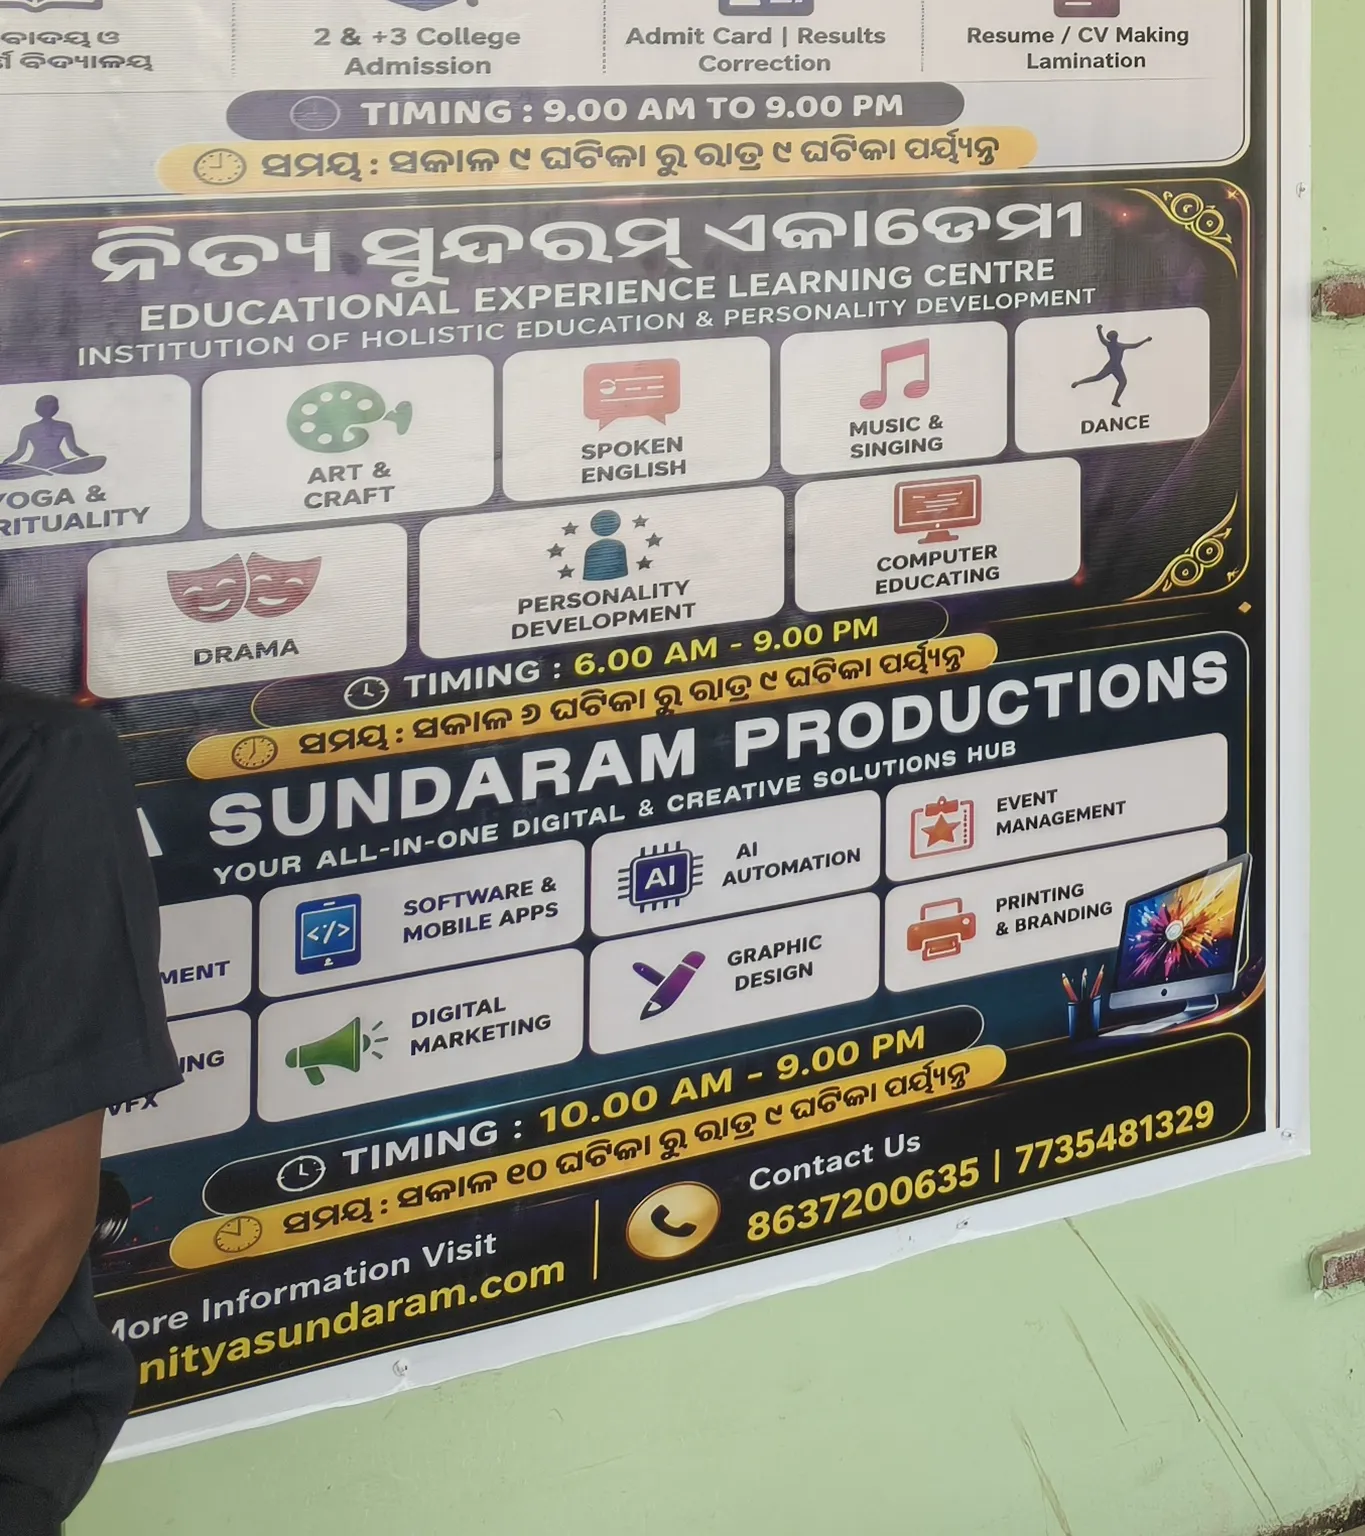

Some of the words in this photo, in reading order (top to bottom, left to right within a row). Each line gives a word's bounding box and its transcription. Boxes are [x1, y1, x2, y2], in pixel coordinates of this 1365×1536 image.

[626, 26, 705, 46] Admit
[712, 26, 773, 46] Card
[797, 26, 886, 45] Results
[966, 26, 1054, 44] Resume
[1077, 26, 1109, 44] CV
[1116, 26, 1189, 48] Making
[698, 54, 831, 73] Correction
[1026, 51, 1146, 70] Lamination
[141, 289, 460, 332] EDUCATIONAL
[473, 276, 715, 313] EXPERIENCE
[728, 266, 912, 298] LEARNING
[924, 259, 1055, 287] CENTRE
[78, 335, 295, 366] INSTITUTION
[307, 332, 350, 352] OF
[361, 323, 505, 348] HOLISTIC
[516, 313, 685, 340] EDUCATION
[696, 310, 714, 327] &
[724, 298, 904, 327] PERSONALITY
[916, 287, 1096, 315] DEVELOPMENT
[876, 544, 998, 573] COMPUTER
[875, 567, 1000, 596] EDUCATING
[209, 729, 695, 847] SUNDARAM
[735, 650, 1228, 766] PRODUCTIONS
[996, 789, 1058, 813] EVENT
[996, 799, 1126, 836] MANAGEMENT
[721, 849, 861, 887] AUTOMATION
[736, 842, 758, 859] AI
[403, 880, 534, 916] SOFTWARE
[541, 876, 557, 892] &
[996, 883, 1085, 913] PRINTING
[403, 913, 492, 944] MOBILE
[499, 902, 559, 928] APPS
[995, 921, 1009, 937] &
[1015, 901, 1113, 932] BRANDING
[727, 935, 822, 967] GRAPHIC
[735, 962, 813, 992] DESIGN
[411, 997, 506, 1028] DIGITAL
[410, 1015, 551, 1057] MARKETING
[342, 1121, 499, 1176] TIMING
[539, 1084, 658, 1133] 10.00
[670, 1068, 732, 1105] AM
[776, 1044, 860, 1081] 9.00
[872, 1025, 926, 1059] PM
[747, 1157, 980, 1242] 8637200635
[1016, 1100, 1215, 1175] 7735481329
[748, 1144, 874, 1194] Contact
[885, 1132, 921, 1159] Us
[139, 1258, 565, 1385] nityasundaram.com
